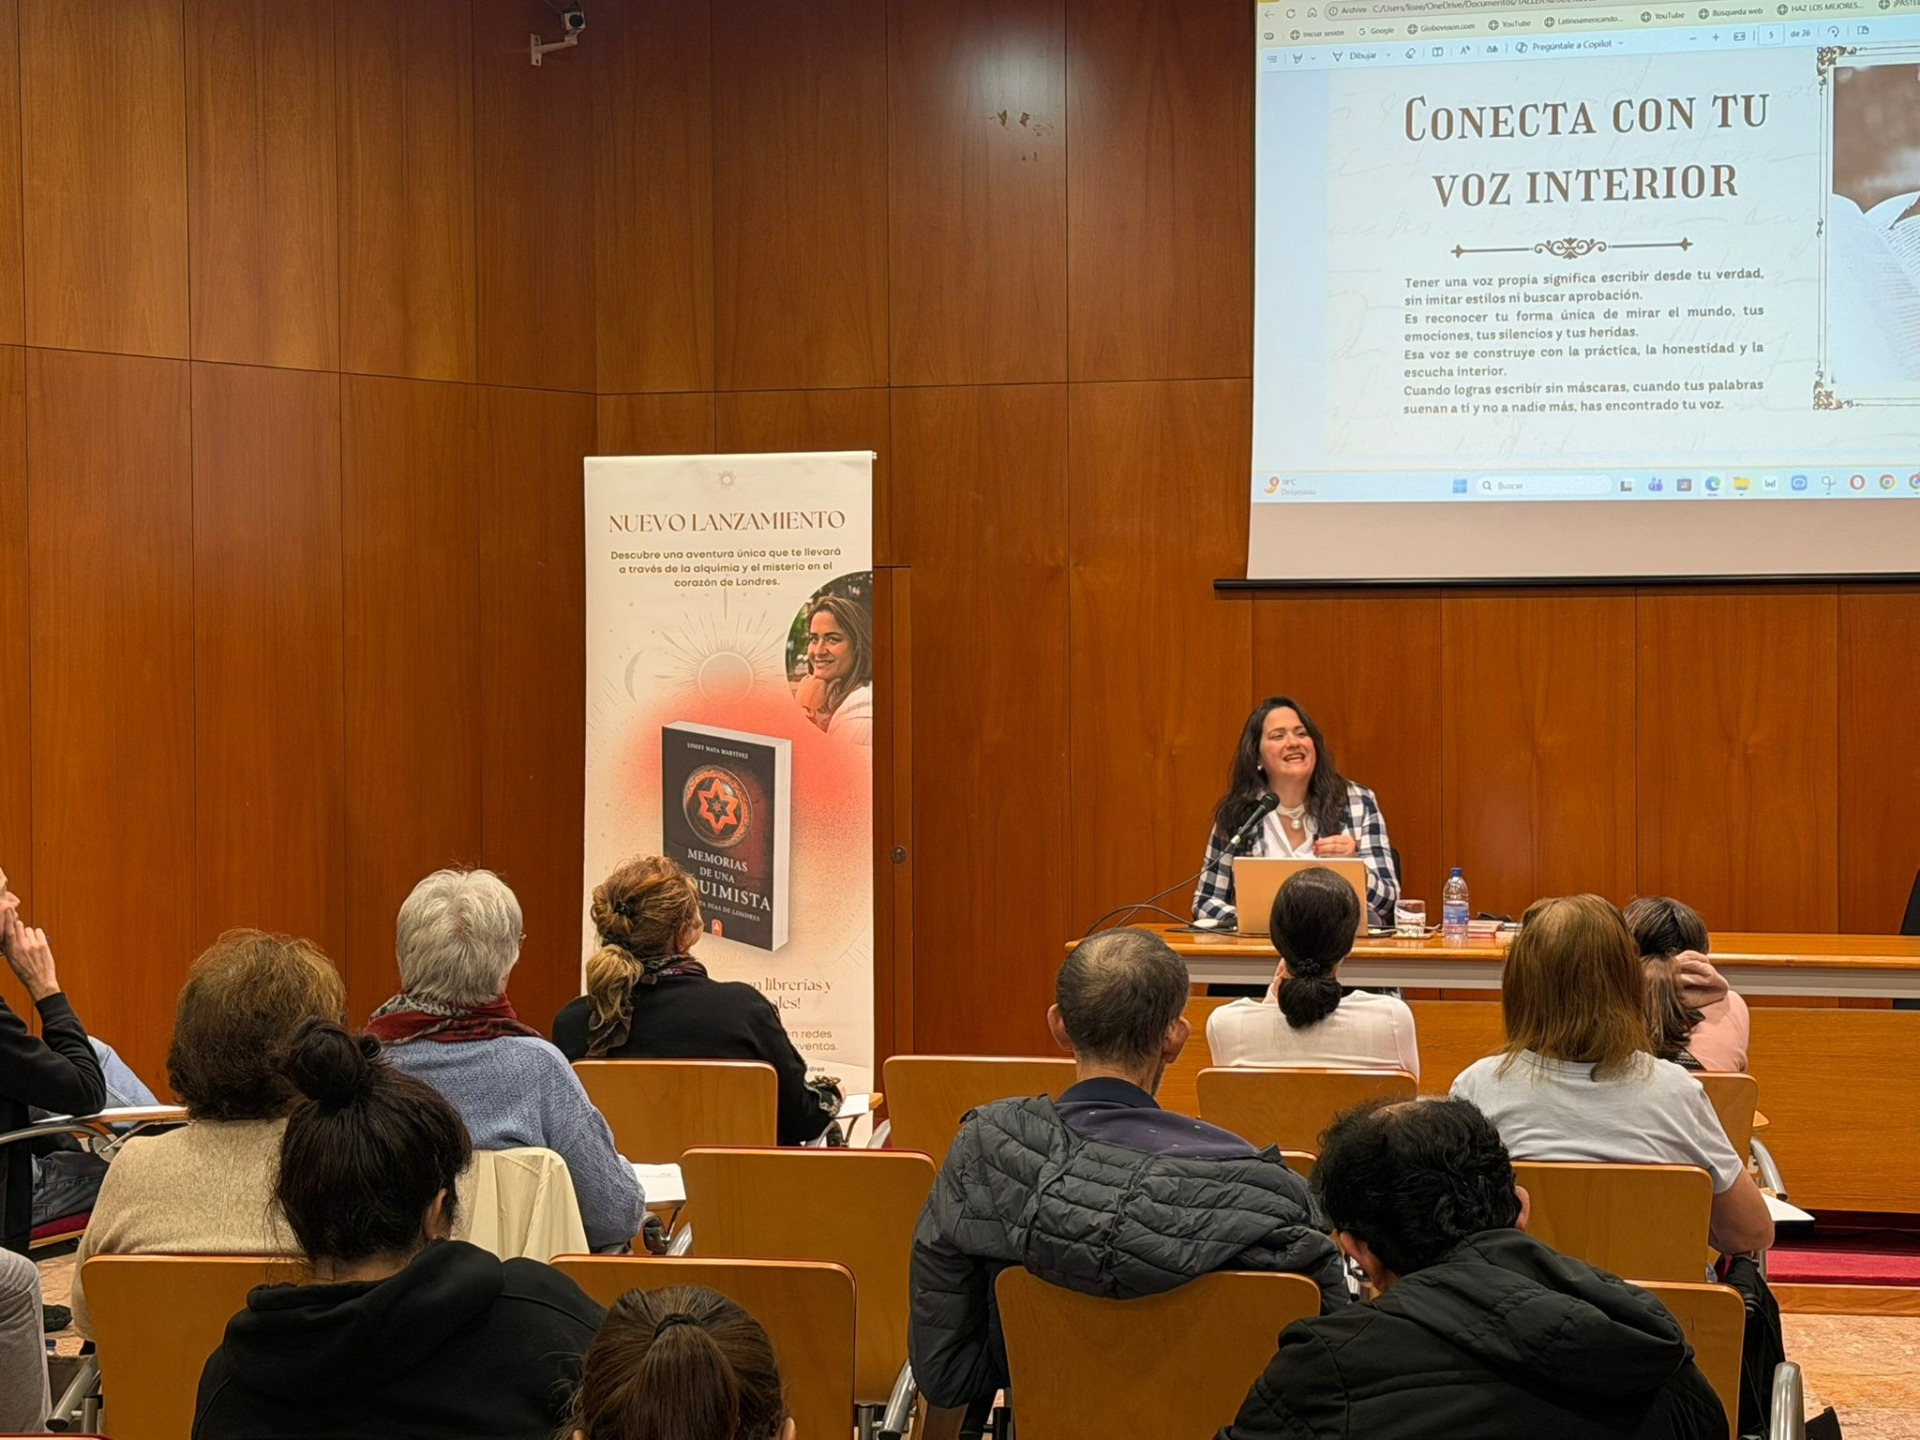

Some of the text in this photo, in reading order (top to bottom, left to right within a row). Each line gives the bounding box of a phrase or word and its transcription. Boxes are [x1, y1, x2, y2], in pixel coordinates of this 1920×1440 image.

[1342, 6, 1367, 14] Archivo
[1370, 27, 1394, 35] Google
[1502, 20, 1531, 28] YouTube
[1802, 29, 1810, 37] 26
[1533, 42, 1575, 52] Pregúntale
[1583, 40, 1612, 50] Copilot
[1350, 52, 1377, 60] Dibujar
[1613, 98, 1696, 132] CON
[1712, 94, 1769, 128] TU
[1432, 164, 1738, 208] VOZ INTERIOR
[1405, 268, 1764, 288] Tener una voz propia significa escribir desde tu verdad,
[1405, 289, 1643, 306] sin imitar estilos ni buscar aprobación.
[1405, 306, 1764, 324] Es reconocer tu forma única de mirar el mundo, tus
[1404, 327, 1638, 341] emociones, tus silencios y tus heridas.
[1404, 342, 1764, 360] Esa voz se construye con la práctica, la honestidad y la
[1404, 366, 1507, 377] escucha interior.
[1404, 380, 1764, 397] Cuando logras escribir sin máscaras, cuando tus palabras
[1404, 404, 1448, 414] suenan
[1451, 405, 1458, 413] a
[1473, 403, 1480, 416] y
[1483, 403, 1498, 413] no
[1501, 404, 1508, 412] a
[1512, 401, 1546, 412] nadie
[1581, 401, 1602, 411] has
[1605, 399, 1678, 411] encontrado
[1683, 400, 1696, 409] tu
[1700, 400, 1724, 409] voz.
[1498, 482, 1523, 490] Buscar
[609, 511, 845, 533] NUEVO LANZAMIENTO
[611, 551, 661, 560] Descubre
[686, 550, 734, 559] aventura
[737, 548, 767, 558] única
[769, 549, 789, 559] que
[804, 548, 841, 556] llevará
[619, 561, 833, 574] a través de la alquimia y el misterio en el
[674, 577, 780, 588] corazón de Londres.
[688, 848, 748, 872] MEMORIAS
[700, 867, 735, 883] DE UNA
[695, 879, 771, 911] UIMISTA
[765, 977, 822, 991] librerías
[825, 981, 833, 993] y
[801, 1030, 832, 1038] redes
